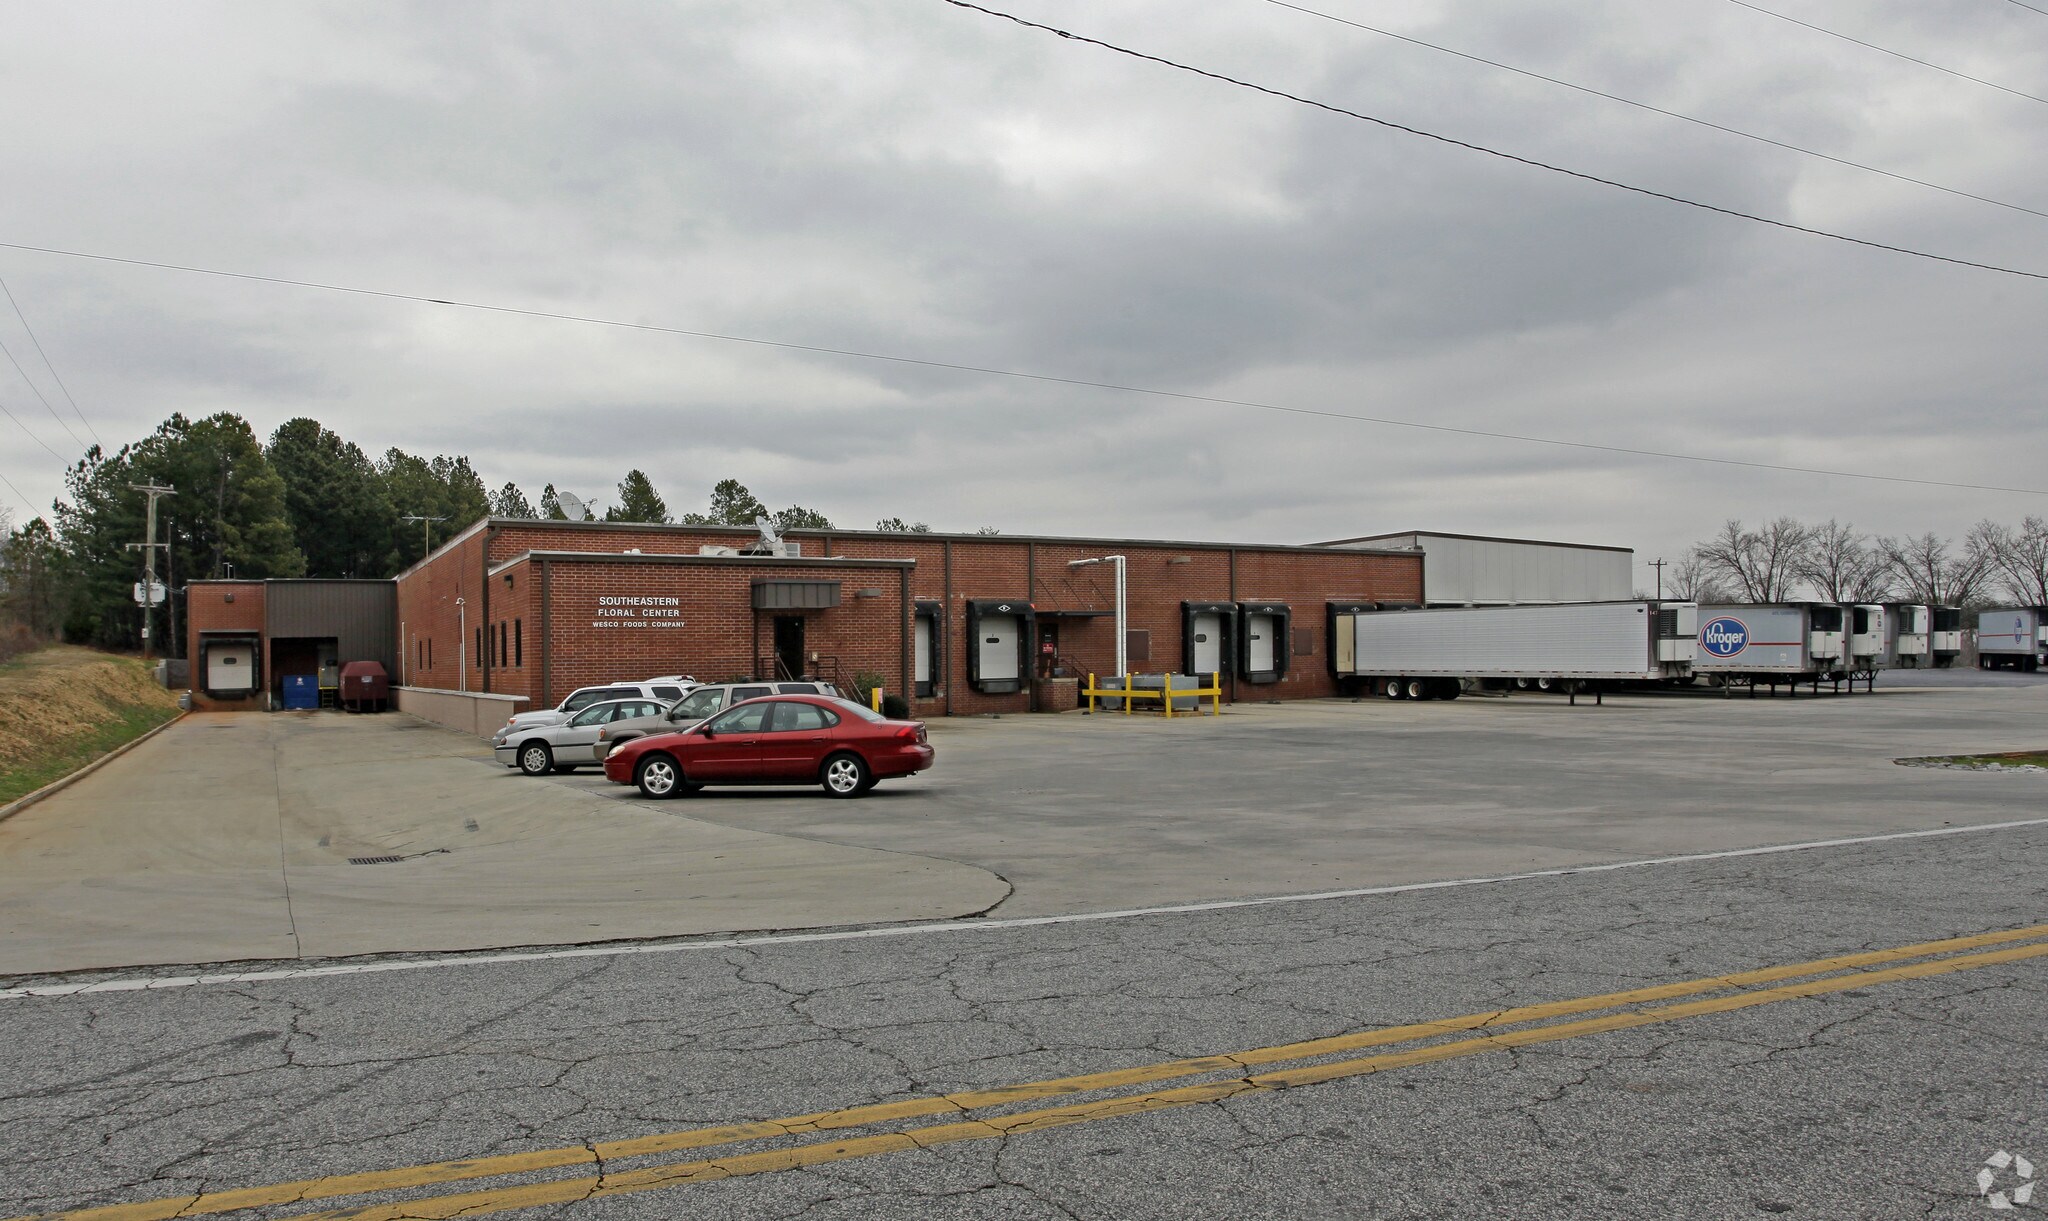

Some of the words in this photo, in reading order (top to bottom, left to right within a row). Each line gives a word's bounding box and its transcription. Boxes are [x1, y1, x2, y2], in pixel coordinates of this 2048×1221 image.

[599, 596, 679, 606] SOUTHEASTERN
[598, 608, 635, 617] FLORAL
[642, 609, 680, 617] CENTER
[1706, 622, 1744, 653] Kroger
